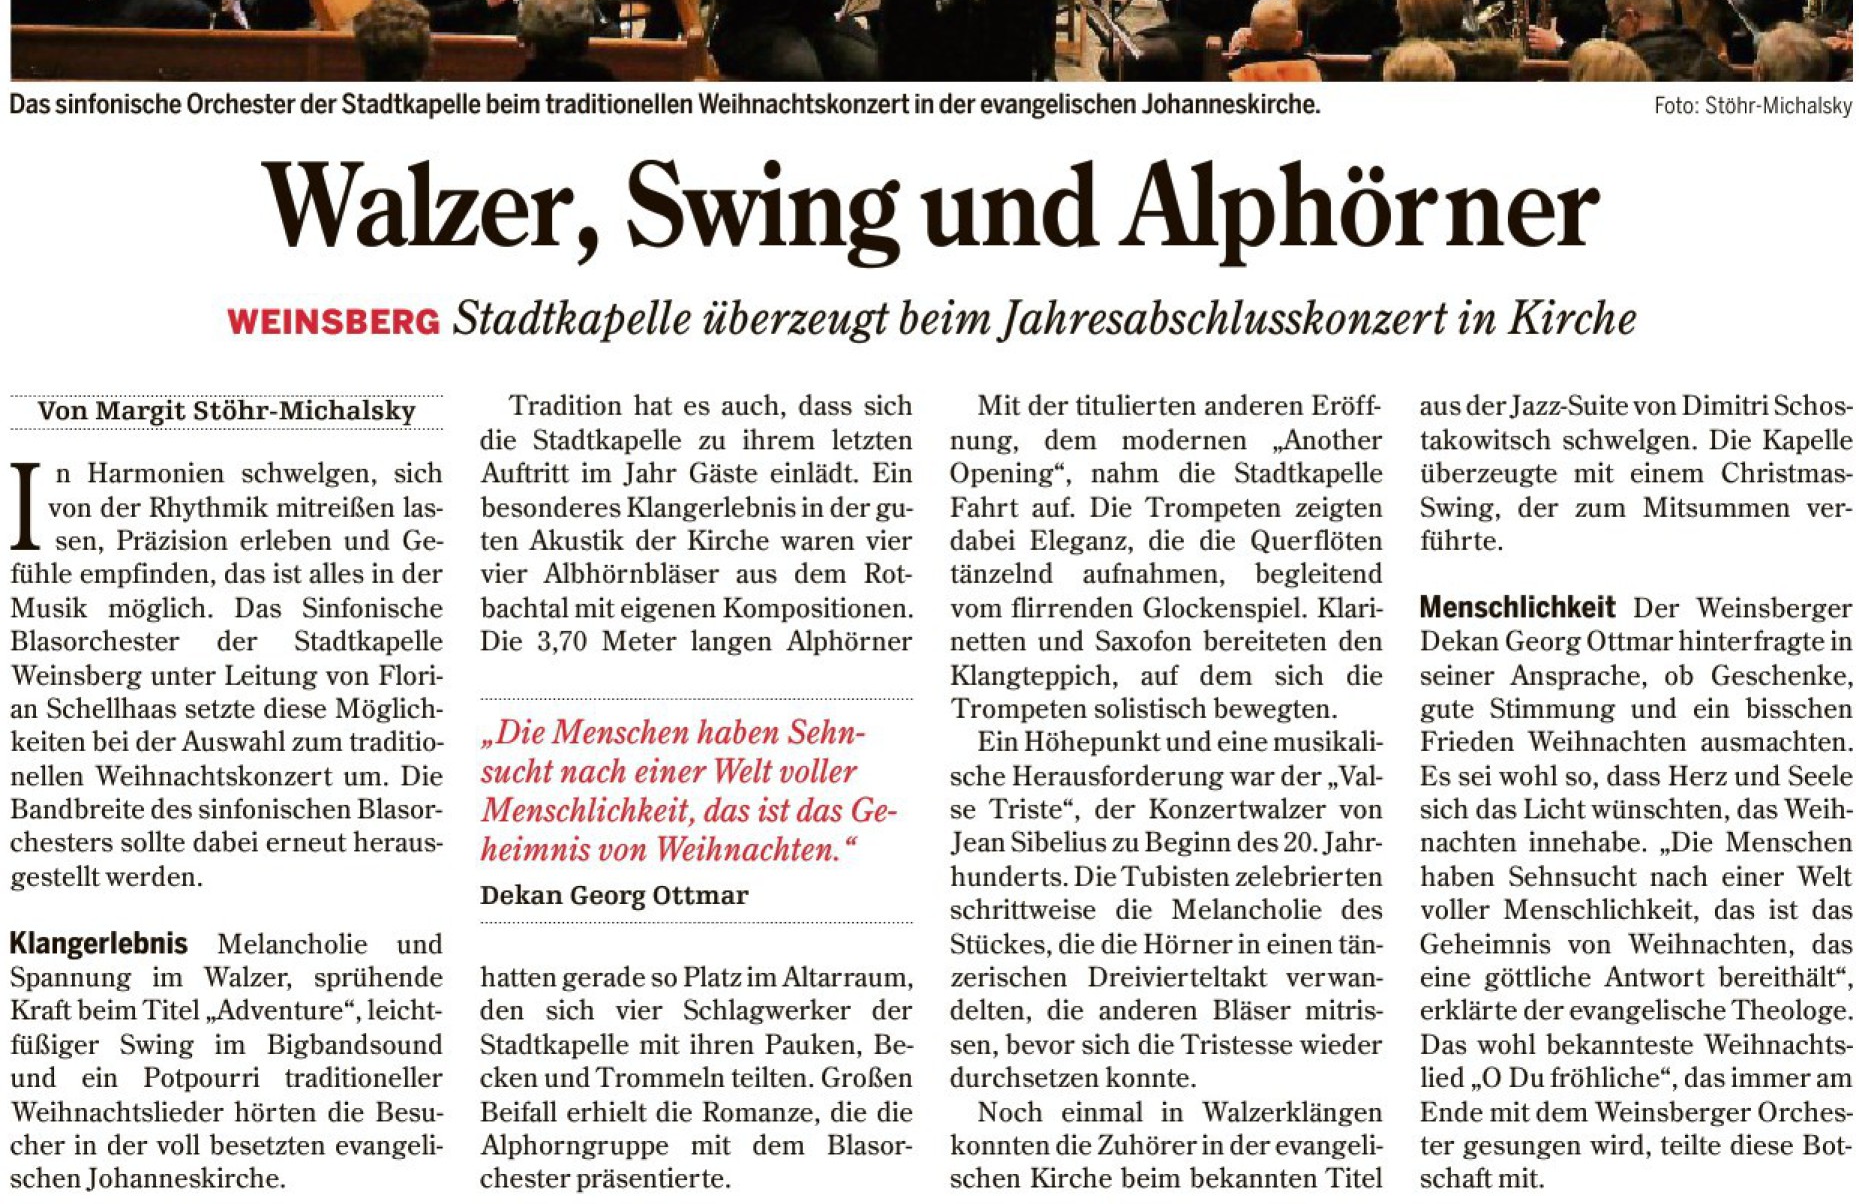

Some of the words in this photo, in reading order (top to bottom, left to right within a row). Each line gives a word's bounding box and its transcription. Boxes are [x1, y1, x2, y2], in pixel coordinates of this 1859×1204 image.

[10, 92, 51, 115] Das
[55, 92, 182, 115] sinfonische
[186, 92, 297, 115] Orchester
[299, 92, 338, 114] der
[341, 91, 481, 120] Stadtkapelle
[486, 92, 540, 115] beim
[545, 92, 693, 114] traditionellen
[698, 92, 910, 115] Weihnachtskonzert
[914, 93, 934, 114] in
[938, 92, 976, 114] der
[980, 92, 1137, 120] evangelischen
[1141, 92, 1321, 115] Johanneskirche.
[1655, 96, 1699, 114] Foto:
[1705, 95, 1853, 119] Stöhr-Michalsky
[260, 159, 599, 267] Walzer,
[626, 159, 901, 269] Swing
[920, 159, 1101, 248] und
[1118, 158, 1601, 268] Alphörner
[227, 307, 440, 335] WEINSBERG
[452, 298, 692, 344] Stadtkapelle
[703, 298, 891, 344] überzeugt
[899, 298, 991, 336] beim
[995, 298, 1449, 344] Jahresabschlusskonzert
[1458, 298, 1497, 335] in
[1507, 298, 1637, 336] Kirche
[37, 400, 89, 421] Von
[95, 399, 187, 427] Margit
[193, 399, 417, 426] Stöhr-Michalsky
[1420, 428, 1551, 451] takowitsch
[1562, 428, 1698, 455] schwelgen.
[1709, 428, 1752, 451] Die
[1762, 428, 1854, 455] Kapelle
[56, 468, 71, 483] n
[87, 461, 225, 484] Harmonien
[241, 461, 377, 488] schwelgen,
[394, 460, 443, 484] sich
[480, 461, 570, 484] Auftritt
[581, 461, 612, 483] im
[622, 461, 677, 487] Jahr
[689, 461, 758, 484] Gäste
[770, 461, 859, 484] einlädt.
[872, 461, 913, 483] Ein
[48, 502, 92, 518] von
[100, 495, 142, 518] der
[149, 495, 269, 522] Rhythmik
[276, 495, 395, 518] mitreißen
[403, 495, 444, 518] las-
[55, 535, 104, 555] sen,
[116, 529, 228, 551] Präzision
[239, 528, 332, 551] erleben
[344, 528, 390, 551] und
[402, 529, 444, 551] Ge-
[950, 528, 1016, 551] dabei
[1030, 528, 1134, 555] Eleganz,
[1148, 528, 1185, 551] die
[1199, 528, 1236, 551] die
[1250, 528, 1383, 554] Querflöten
[10, 561, 73, 584] fühle
[80, 561, 216, 589] empfinden,
[224, 561, 266, 584] das
[273, 562, 302, 584] ist
[309, 561, 364, 584] alles
[372, 562, 394, 584] in
[401, 561, 444, 584] der
[1420, 594, 1617, 619] Menschlichkeit
[1633, 597, 1680, 619] Der
[1696, 596, 1853, 623] Weinsberger
[480, 629, 523, 652] Die
[537, 630, 588, 655] 3,70
[602, 630, 677, 652] Meter
[690, 629, 772, 656] langen
[785, 629, 913, 656] Alphörner
[950, 697, 1087, 724] Trompeten
[1094, 696, 1207, 719] solistisch
[1213, 696, 1338, 723] bewegten.
[481, 718, 546, 749] „Die
[551, 718, 689, 745] Menschen
[696, 718, 780, 745] haben
[787, 718, 865, 745] Sehn-
[480, 757, 554, 784] sucht
[560, 757, 626, 784] nach
[634, 757, 708, 784] einer
[714, 757, 774, 784] Welt
[779, 757, 859, 784] voller
[480, 796, 696, 827] Menschlichkeit,
[703, 796, 751, 823] das
[758, 796, 791, 823] ist
[796, 796, 843, 823] das
[851, 796, 898, 823] Ge-
[479, 834, 591, 862] heimnis
[598, 843, 647, 862] von
[657, 835, 858, 862] Weihnachten.“
[479, 883, 564, 905] Dekan
[570, 885, 646, 911] Georg
[653, 885, 750, 906] Ottmar
[950, 897, 1096, 920] schrittweise
[1115, 897, 1153, 920] die
[1171, 897, 1323, 920] Melancholie
[1341, 897, 1383, 920] des
[1420, 897, 1491, 920] voller
[1504, 897, 1699, 924] Menschlichkeit,
[1714, 897, 1755, 920] das
[1769, 898, 1798, 920] ist
[1812, 897, 1854, 920] das
[9, 930, 189, 961] Klangerlebnis
[217, 932, 368, 955] Melancholie
[397, 932, 443, 955] und
[10, 998, 72, 1021] Kraft
[77, 998, 138, 1021] beim
[142, 998, 200, 1021] Titel
[206, 998, 362, 1025] „Adventure“,
[367, 998, 443, 1021] leicht-
[1420, 1065, 1465, 1088] lied
[1471, 1065, 1502, 1092] „O
[1509, 1066, 1545, 1088] Du
[1550, 1065, 1678, 1092] fröhliche“,
[1684, 1065, 1726, 1088] das
[1731, 1066, 1812, 1088] immer
[1816, 1072, 1853, 1088] am
[480, 1100, 558, 1123] Beifall
[566, 1100, 647, 1123] erhielt
[656, 1100, 693, 1123] die
[702, 1101, 820, 1125] Romanze,
[830, 1100, 867, 1123] die
[877, 1100, 913, 1123] die
[479, 1166, 571, 1189] chester
[576, 1167, 731, 1193] präsentierte.
[950, 1166, 1021, 1189] schen
[1030, 1166, 1113, 1189] Kirche
[1120, 1166, 1181, 1189] beim
[1189, 1166, 1318, 1189] bekannten
[1324, 1166, 1383, 1189] Titel
[1420, 1166, 1493, 1189] schaft
[1498, 1167, 1545, 1189] mit.
